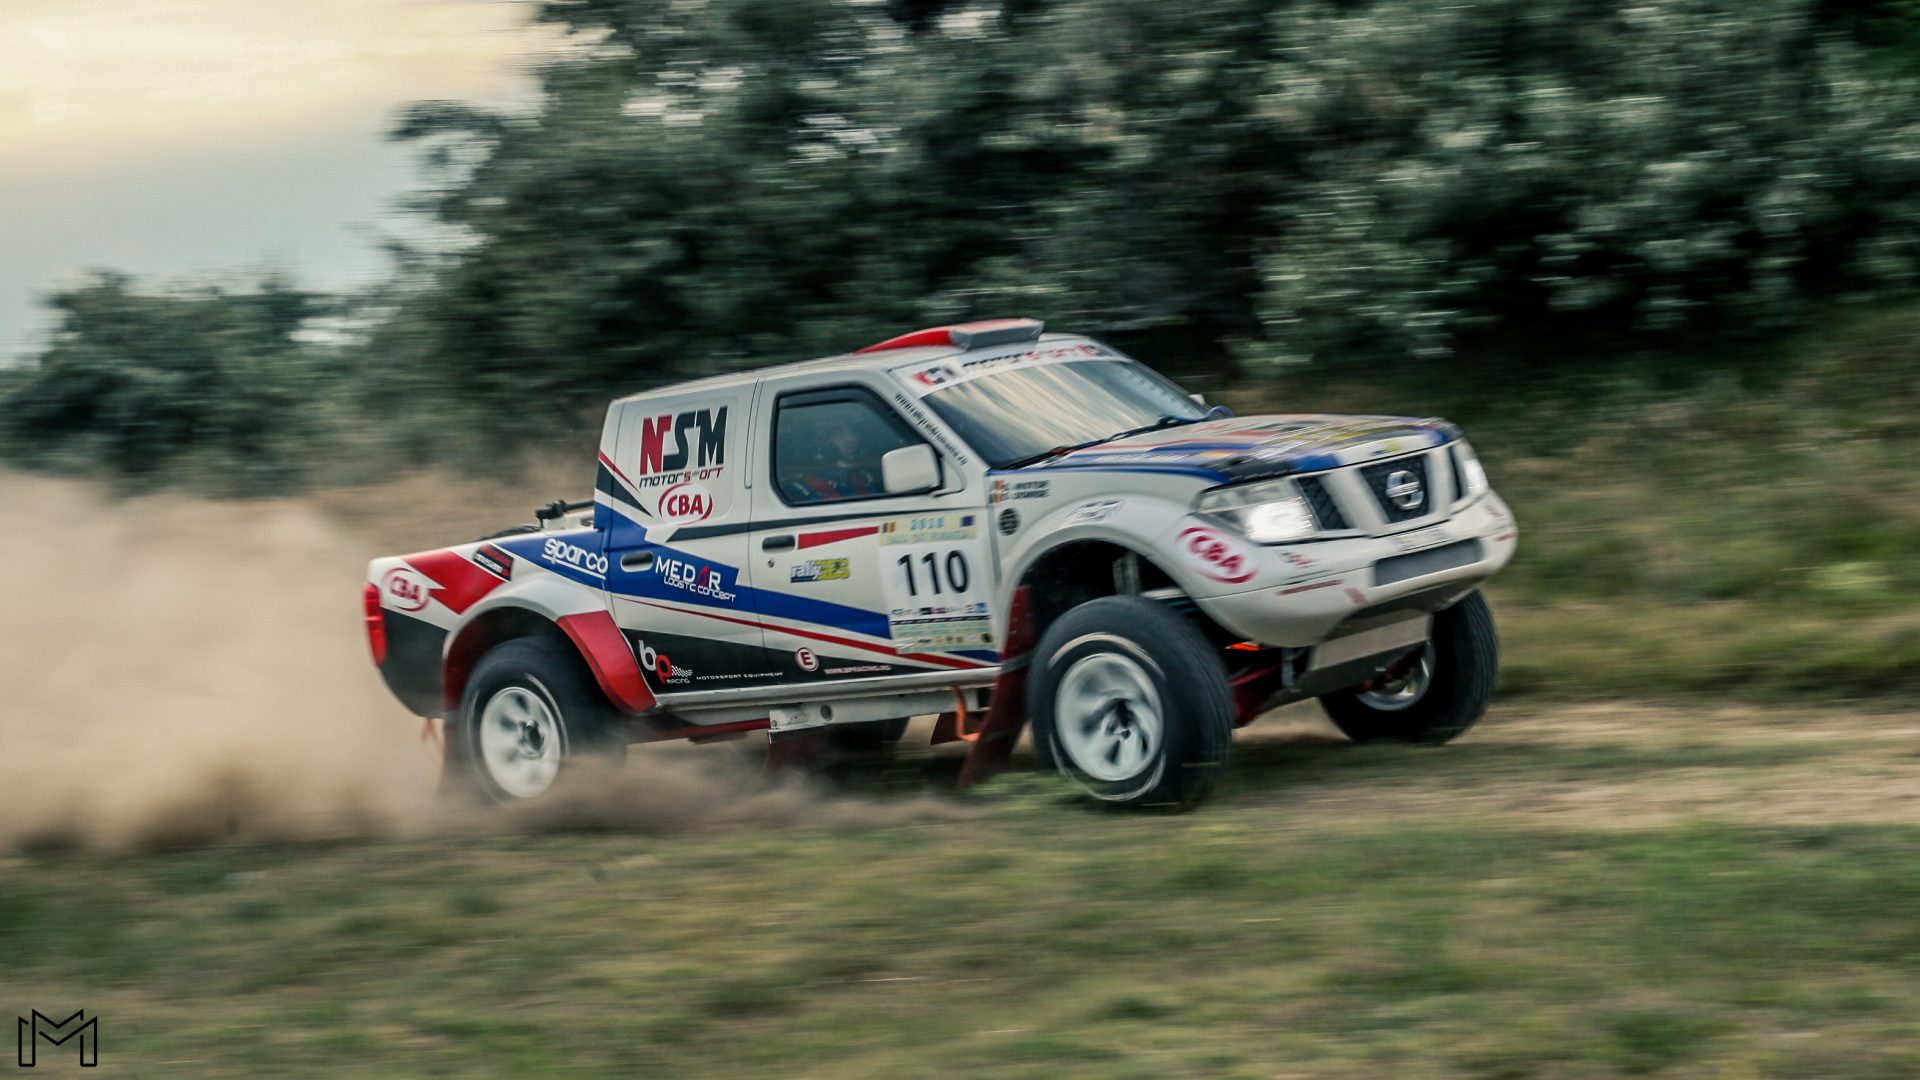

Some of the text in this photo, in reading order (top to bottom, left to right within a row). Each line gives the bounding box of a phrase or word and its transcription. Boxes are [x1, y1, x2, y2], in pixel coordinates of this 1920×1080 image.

[639, 406, 728, 476] NSM
[667, 494, 703, 517] CBA
[543, 537, 609, 574] sparco
[655, 554, 721, 592] MEDAR
[897, 549, 971, 597] 110
[1188, 535, 1245, 575] CBA
[391, 576, 420, 604] CBA
[696, 671, 784, 681] MOTORSPORT EQUIPMENT
[801, 652, 813, 666] E
